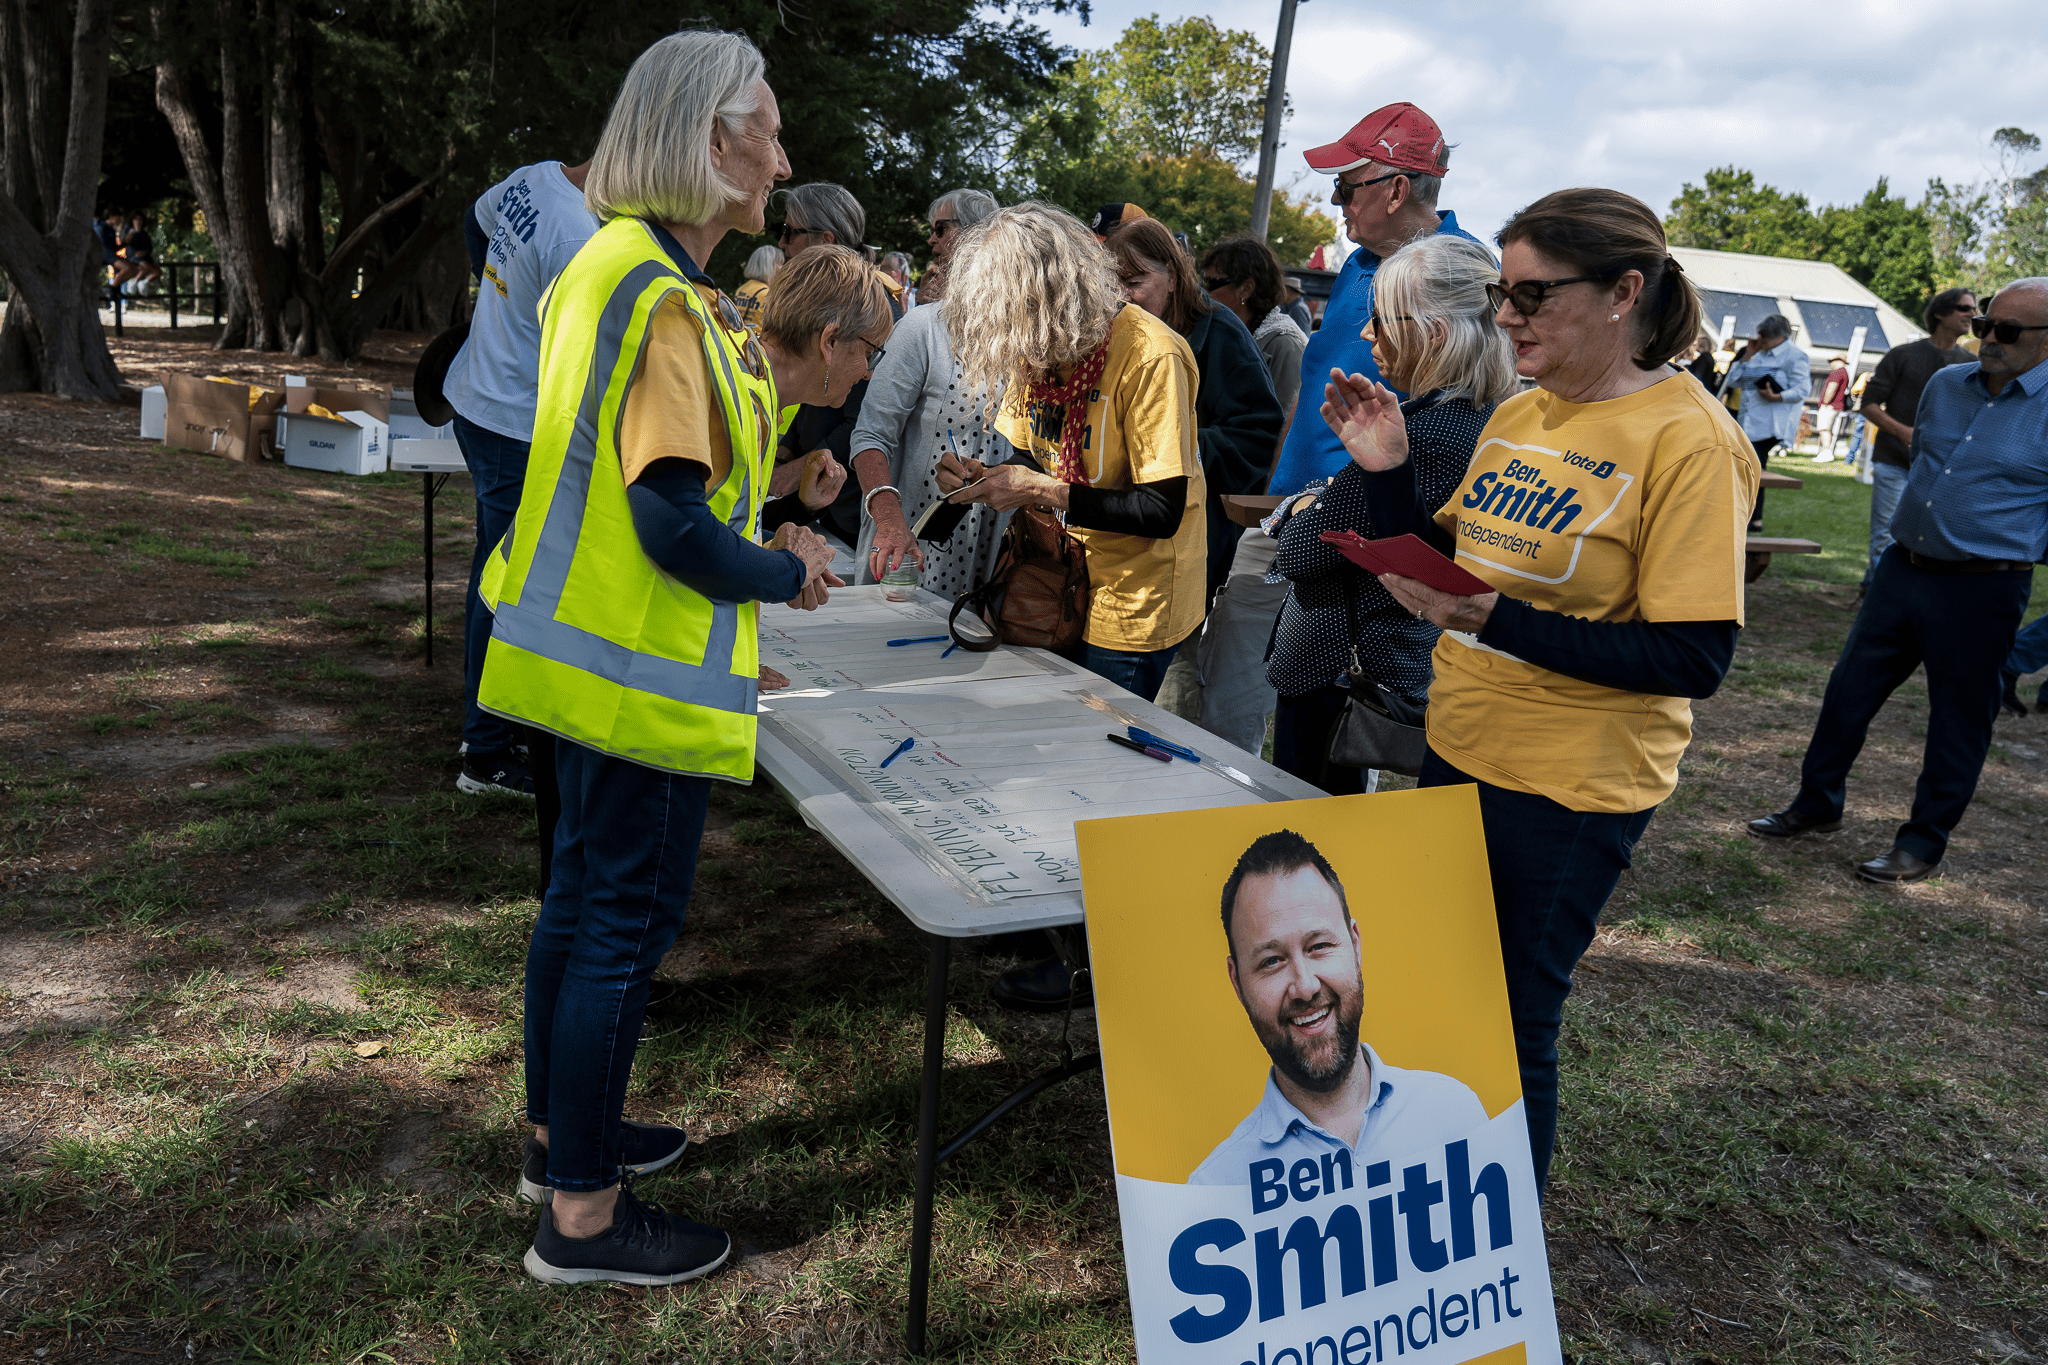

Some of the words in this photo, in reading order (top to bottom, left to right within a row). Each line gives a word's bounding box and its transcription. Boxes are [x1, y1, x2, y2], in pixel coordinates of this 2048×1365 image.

[497, 185, 540, 245] Smith
[309, 440, 336, 450] GILDAN
[1503, 459, 1540, 484] Ben
[1562, 450, 1597, 470] Vote
[1462, 472, 1583, 534] Smith
[907, 755, 931, 767] FRI
[838, 748, 931, 815] MORNINGTON
[901, 775, 941, 802] SCHEDULE
[934, 777, 966, 795] THU
[963, 798, 990, 815] WED
[942, 808, 985, 834] WEEKLY
[988, 824, 1027, 844] TUE
[1023, 851, 1081, 883] MON
[1249, 1147, 1355, 1215] Ben
[1168, 1138, 1514, 1345] Smith
